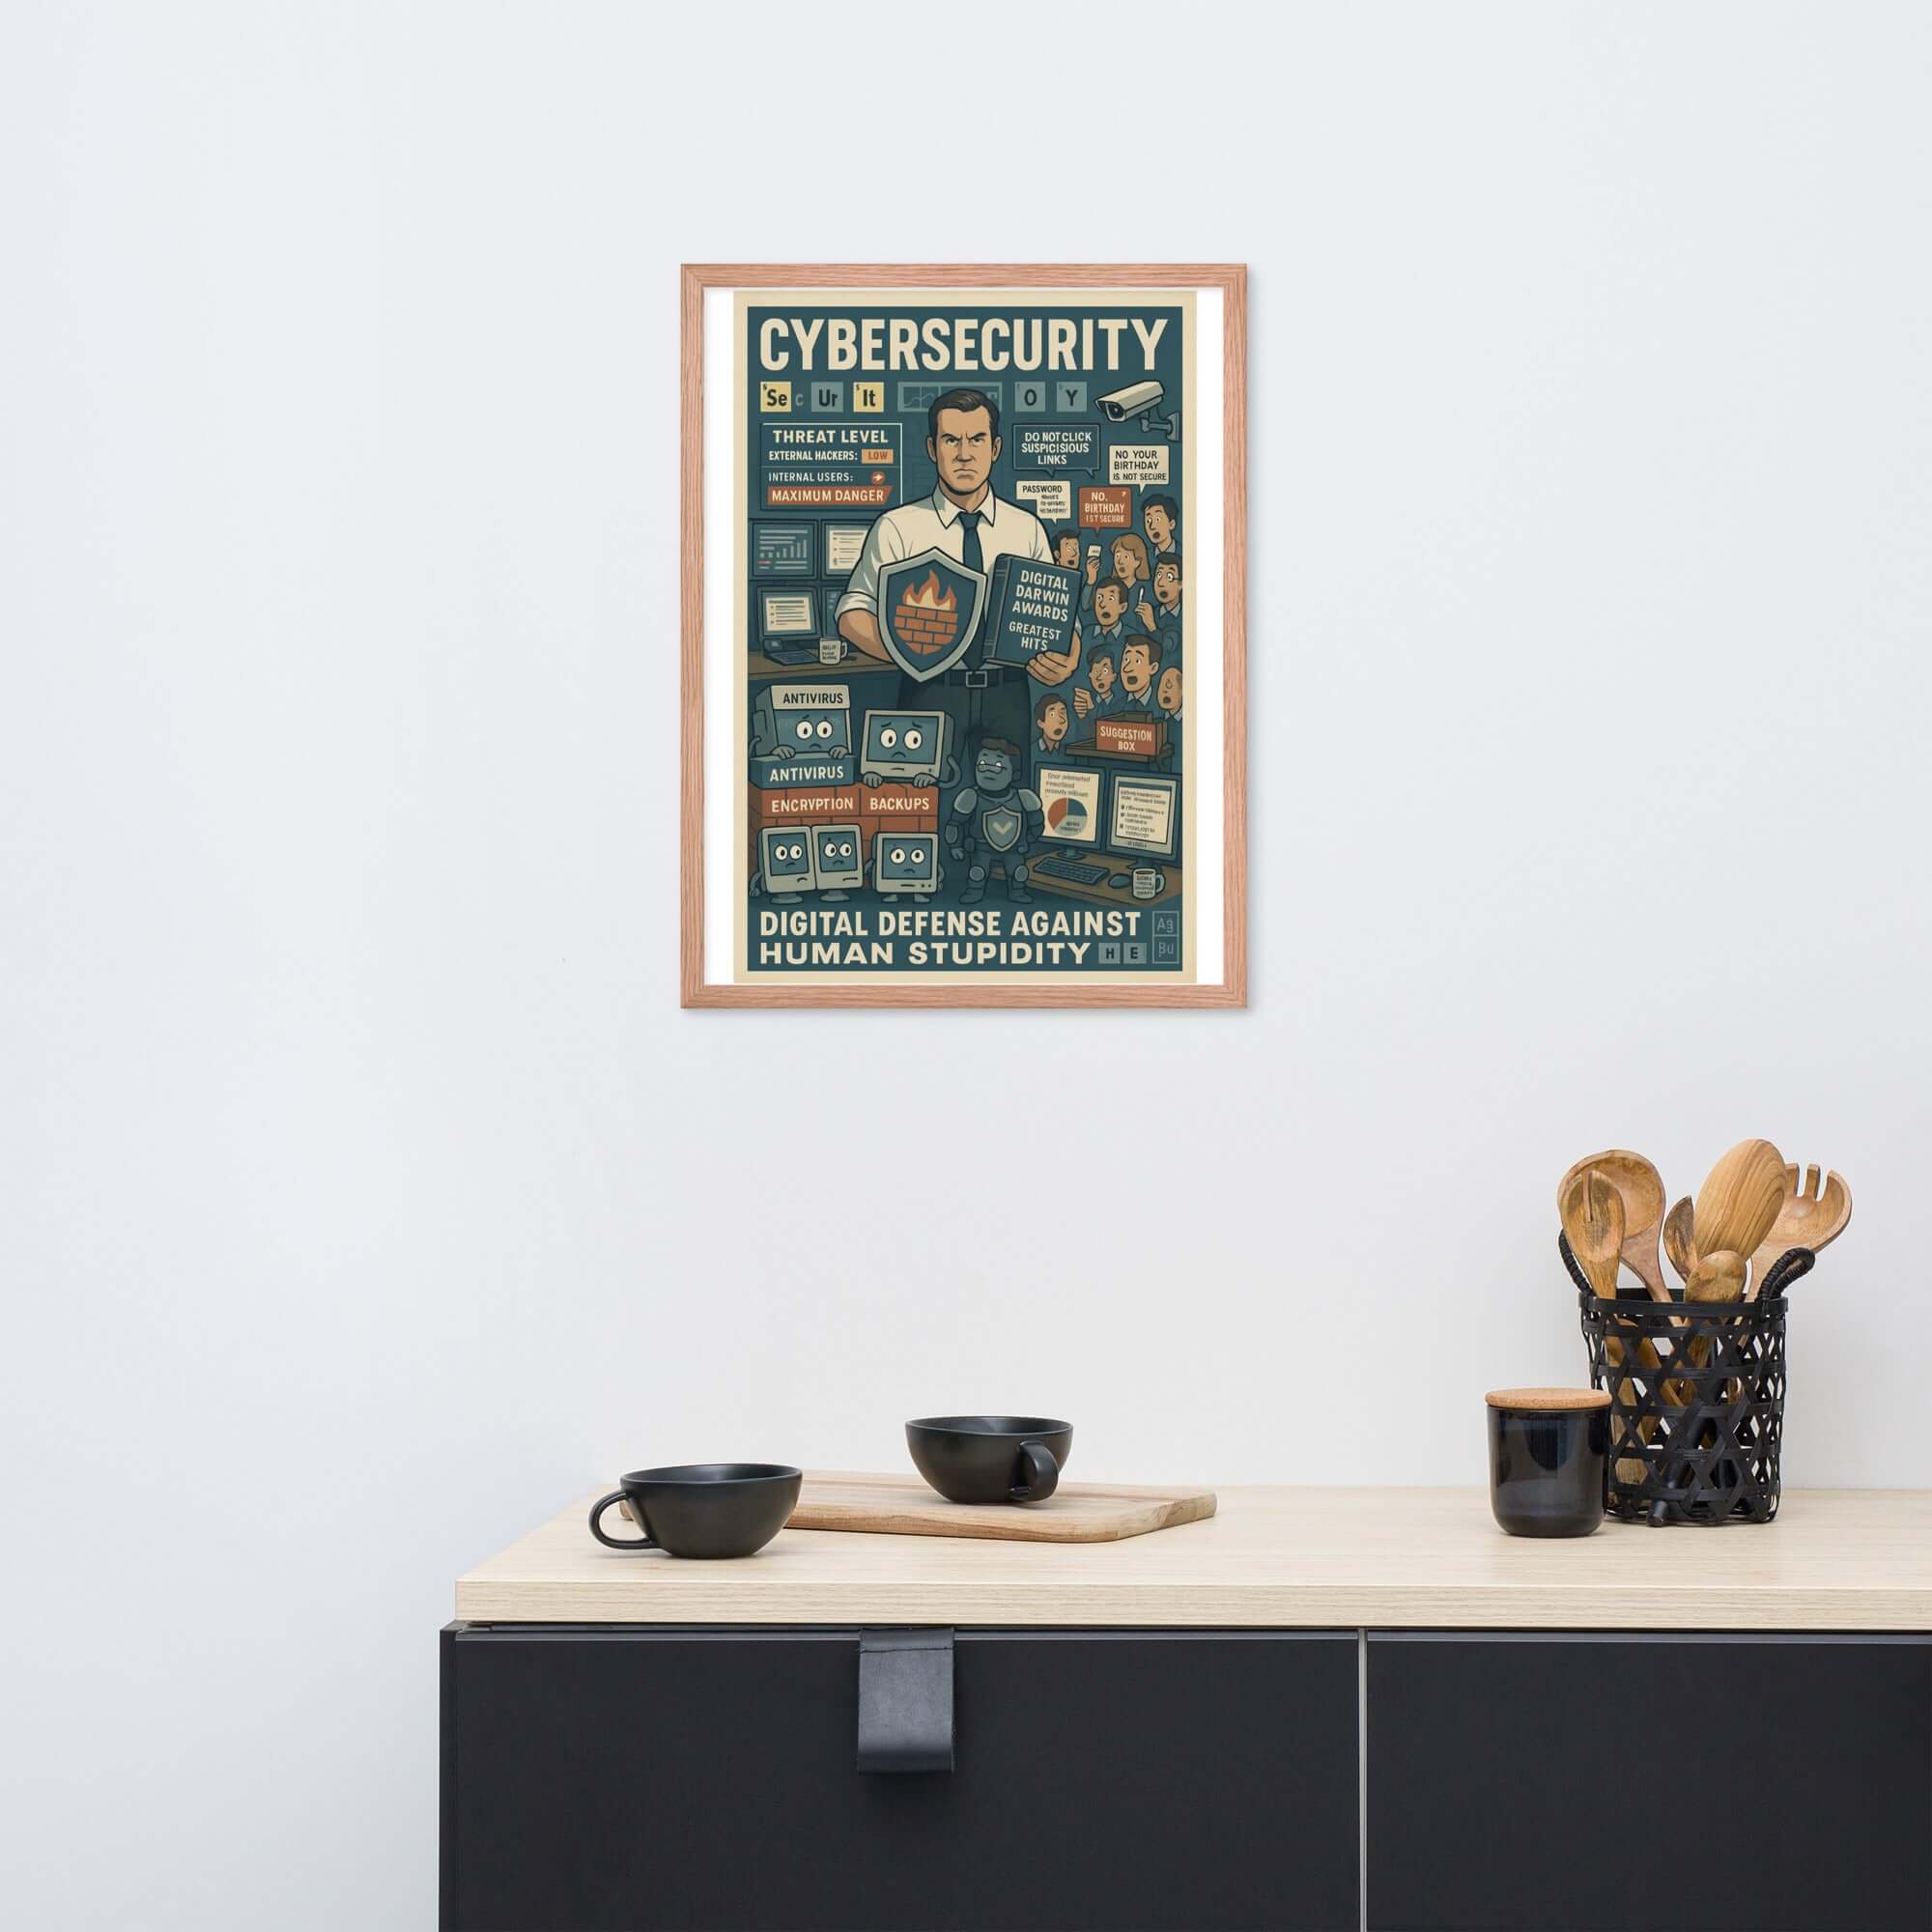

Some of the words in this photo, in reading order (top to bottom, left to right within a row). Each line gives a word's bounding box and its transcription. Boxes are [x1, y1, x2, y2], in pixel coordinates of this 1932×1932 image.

[760, 318, 1168, 371] CYBERSECURITY
[766, 388, 787, 407] Se
[818, 389, 838, 407] Ur
[863, 389, 876, 407] It
[1065, 389, 1078, 407] Y
[773, 430, 836, 443] THREAT
[840, 430, 889, 443] LEVEL
[1025, 432, 1039, 441] DO
[1042, 432, 1061, 441] NOT
[1062, 432, 1092, 441] CLICK
[769, 450, 812, 461] EXTERNAL
[815, 450, 858, 461] HACKERS:
[867, 451, 888, 460] LOW
[1037, 455, 1067, 465] LINKS
[1115, 450, 1128, 459] NO
[1132, 450, 1157, 459] YOUR
[1114, 461, 1159, 470] BIRTHDAY
[769, 472, 814, 482] INTERNAL
[817, 472, 854, 482] USERS:
[773, 490, 831, 501] MAXIMUM
[835, 490, 884, 501] DANGER
[1022, 485, 1063, 494] PASSWORD
[1091, 492, 1108, 501] NO.
[1084, 502, 1125, 513] BIRTHDAY
[1020, 570, 1068, 591] DIGITAL
[1015, 584, 1069, 606] DARWIN
[1011, 600, 1068, 622] AWARDS
[1009, 620, 1062, 640] GREATEST
[1021, 636, 1048, 651] HITS
[782, 693, 843, 704] ANTIVIRUS
[1100, 725, 1152, 742] SUGGESTION
[1118, 740, 1136, 752] BOX
[770, 765, 844, 782] ANTIVIRUS
[869, 797, 930, 810] BACKUPS
[759, 911, 868, 936] DIGITAL
[878, 911, 1002, 936] DEFENSE
[1010, 911, 1142, 936] AGAINST
[759, 942, 894, 965] HUMAN
[908, 941, 1092, 965] STUPIDITY
[1105, 948, 1115, 959] H
[1129, 947, 1139, 959] E
